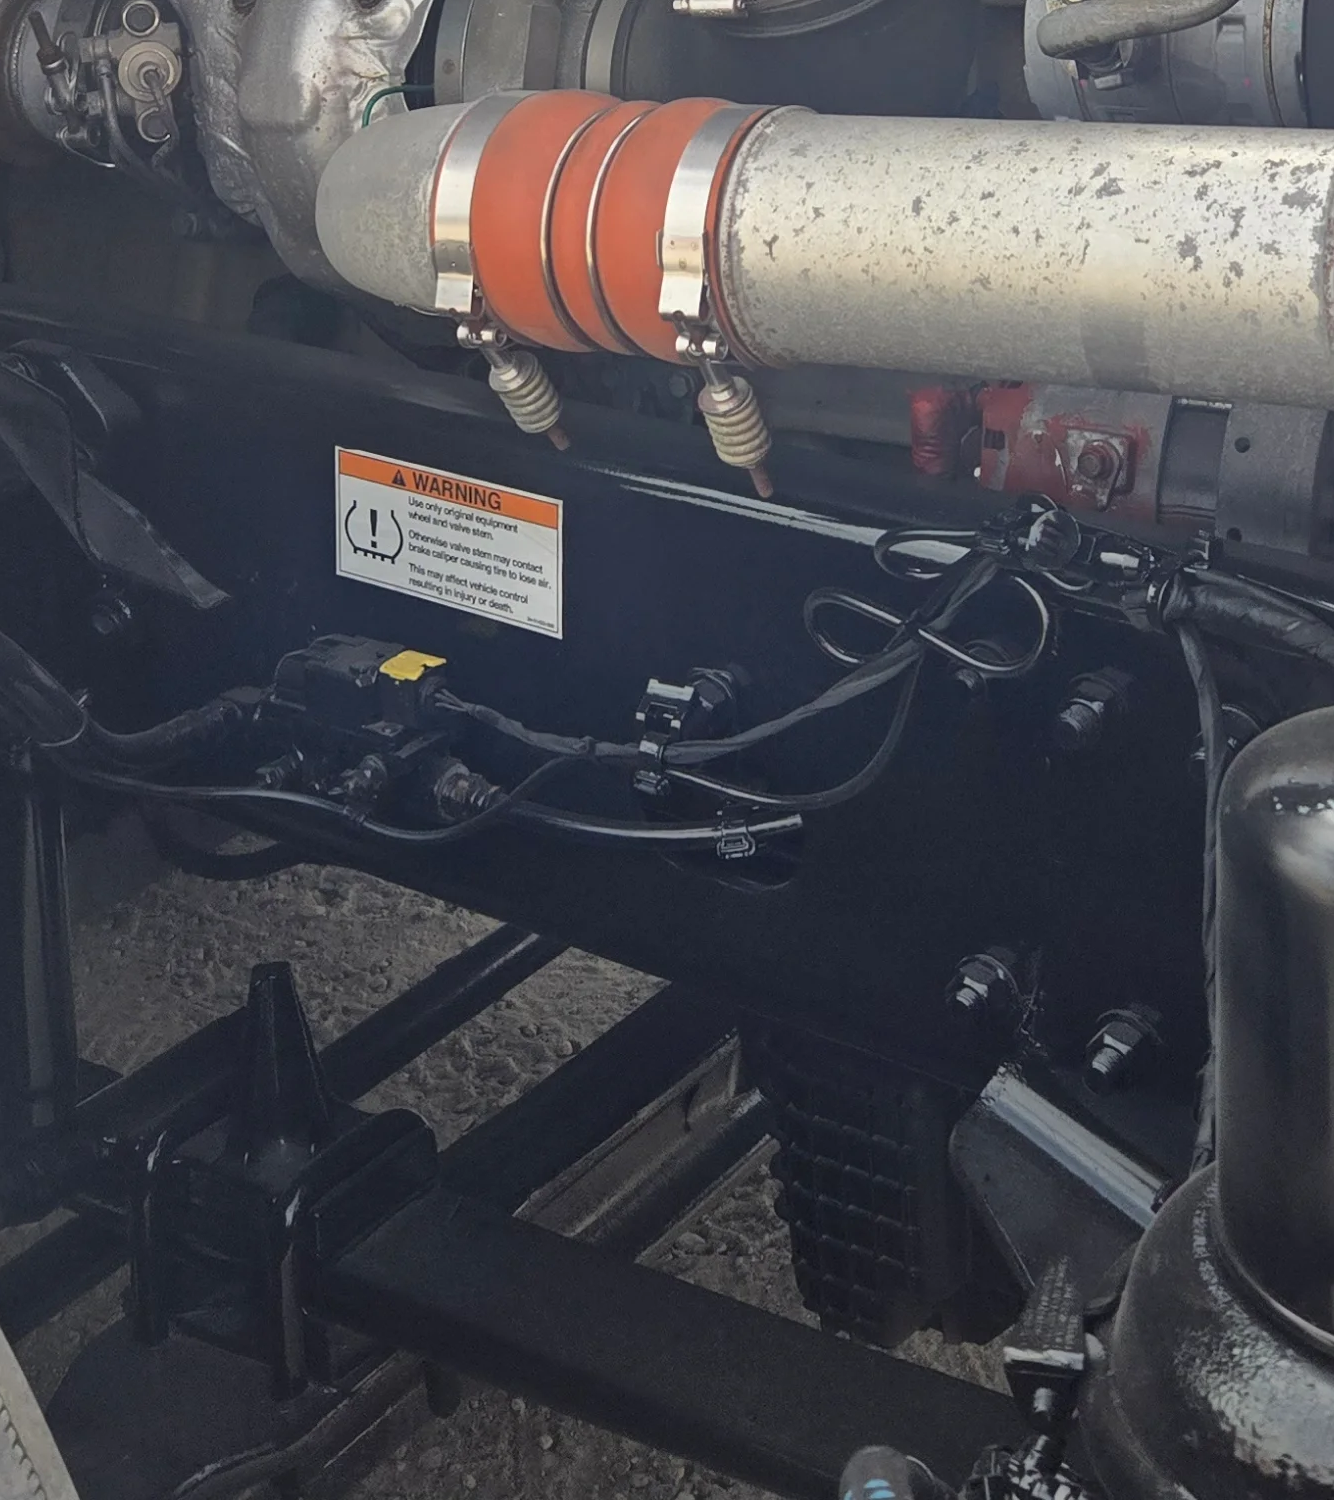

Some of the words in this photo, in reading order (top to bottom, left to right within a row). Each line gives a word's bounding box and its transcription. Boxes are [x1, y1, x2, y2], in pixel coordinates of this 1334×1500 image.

[412, 471, 502, 512] WARNING
[408, 496, 424, 509] Use
[425, 501, 443, 515] only
[444, 504, 474, 522] original
[475, 513, 519, 534] equipment
[408, 511, 431, 524] wheel
[432, 516, 448, 529] and
[449, 520, 471, 534] valve
[472, 526, 494, 541] stem.
[408, 529, 448, 547] Otherwise
[449, 538, 471, 554] valve
[472, 546, 493, 560] stem
[493, 553, 511, 567] may
[512, 558, 543, 574] contact
[409, 543, 431, 557] brake
[432, 549, 459, 565] caliper
[460, 558, 492, 575] causing
[493, 563, 507, 577] tire
[508, 567, 517, 579] to
[519, 569, 537, 585] lose
[409, 563, 425, 576] This
[427, 569, 444, 583] may
[445, 572, 468, 587] affect
[469, 579, 498, 596] vehicle
[499, 587, 529, 604] control
[409, 576, 443, 595] resulting
[444, 585, 452, 596] in
[453, 587, 477, 605] injury
[478, 597, 488, 606] or
[489, 599, 514, 614] death.
